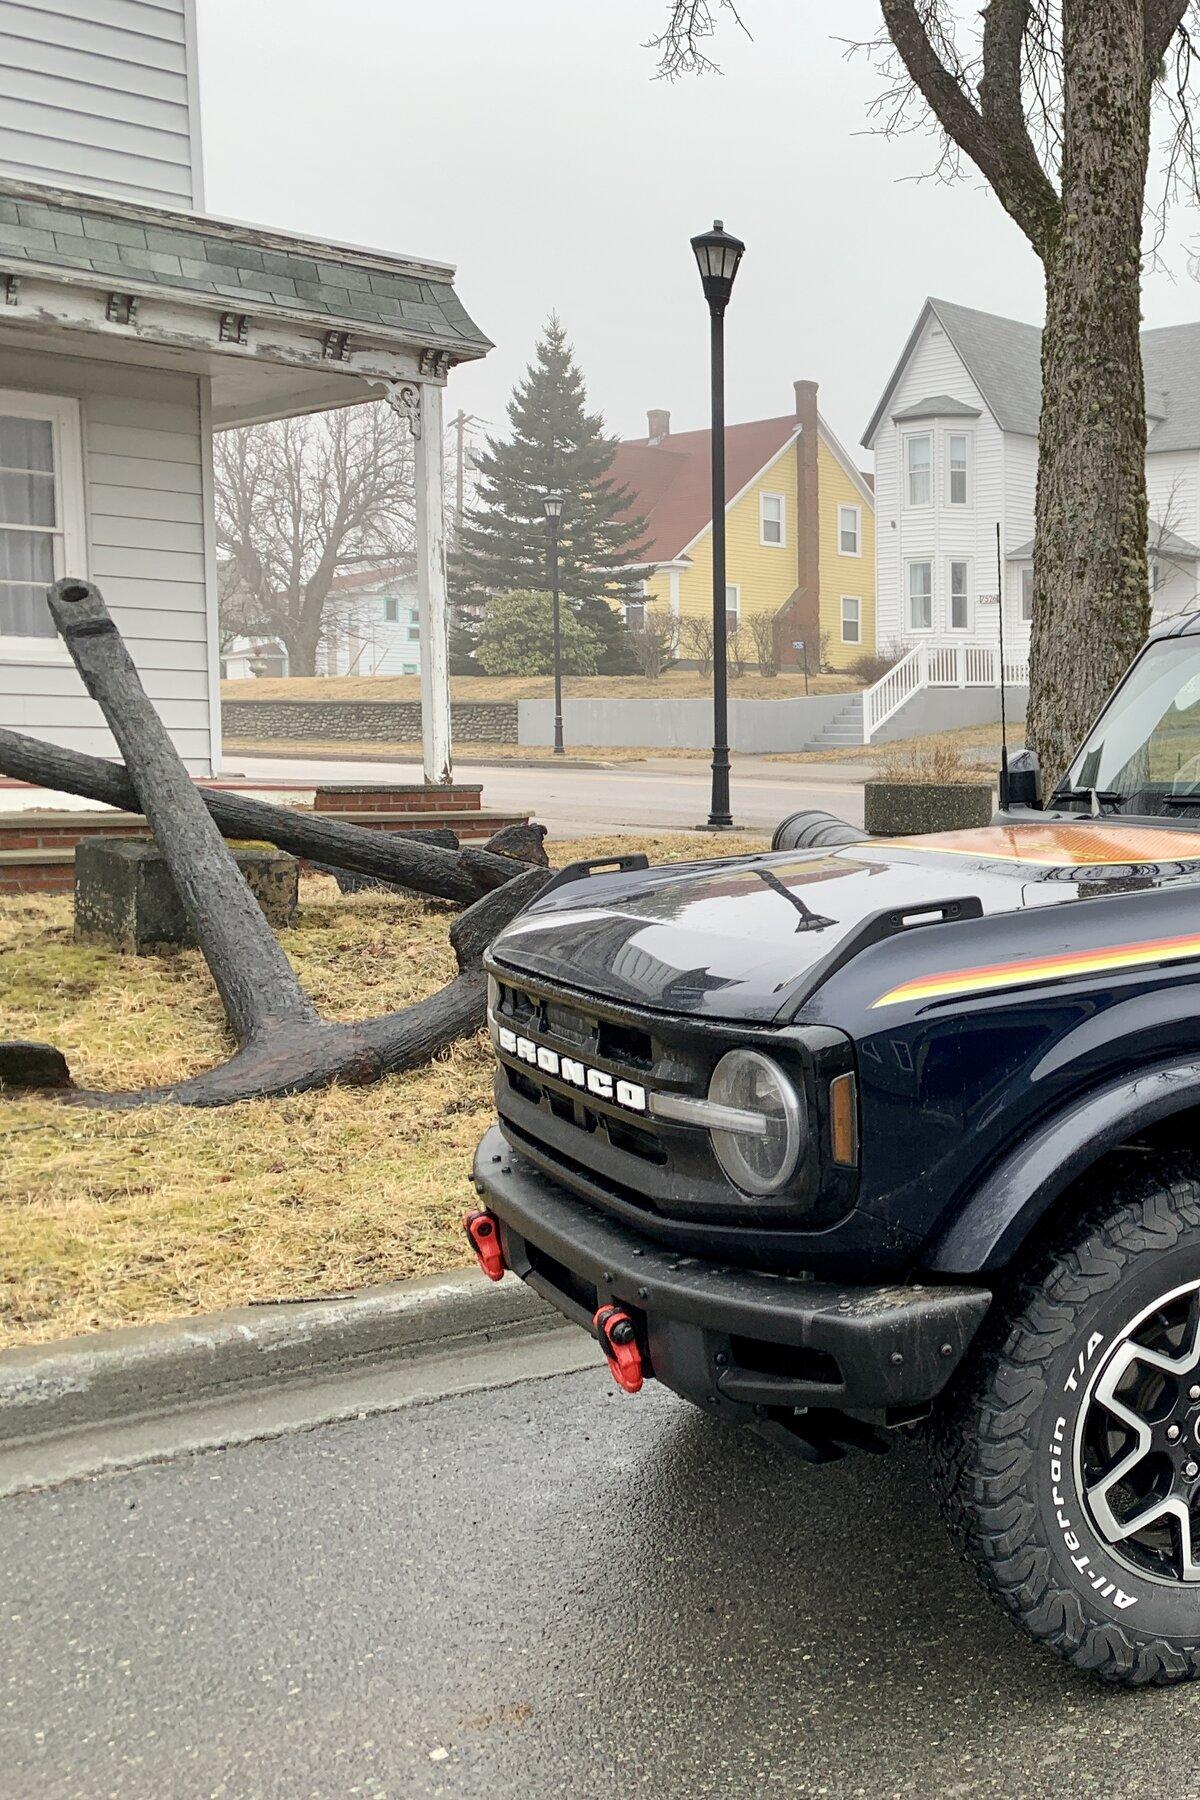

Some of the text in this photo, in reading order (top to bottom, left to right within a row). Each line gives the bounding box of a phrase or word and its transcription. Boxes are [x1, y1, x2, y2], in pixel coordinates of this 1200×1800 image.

[499, 1026, 646, 1110] BRONCO
[1047, 1331, 1138, 1610] All-Terrain T/A
